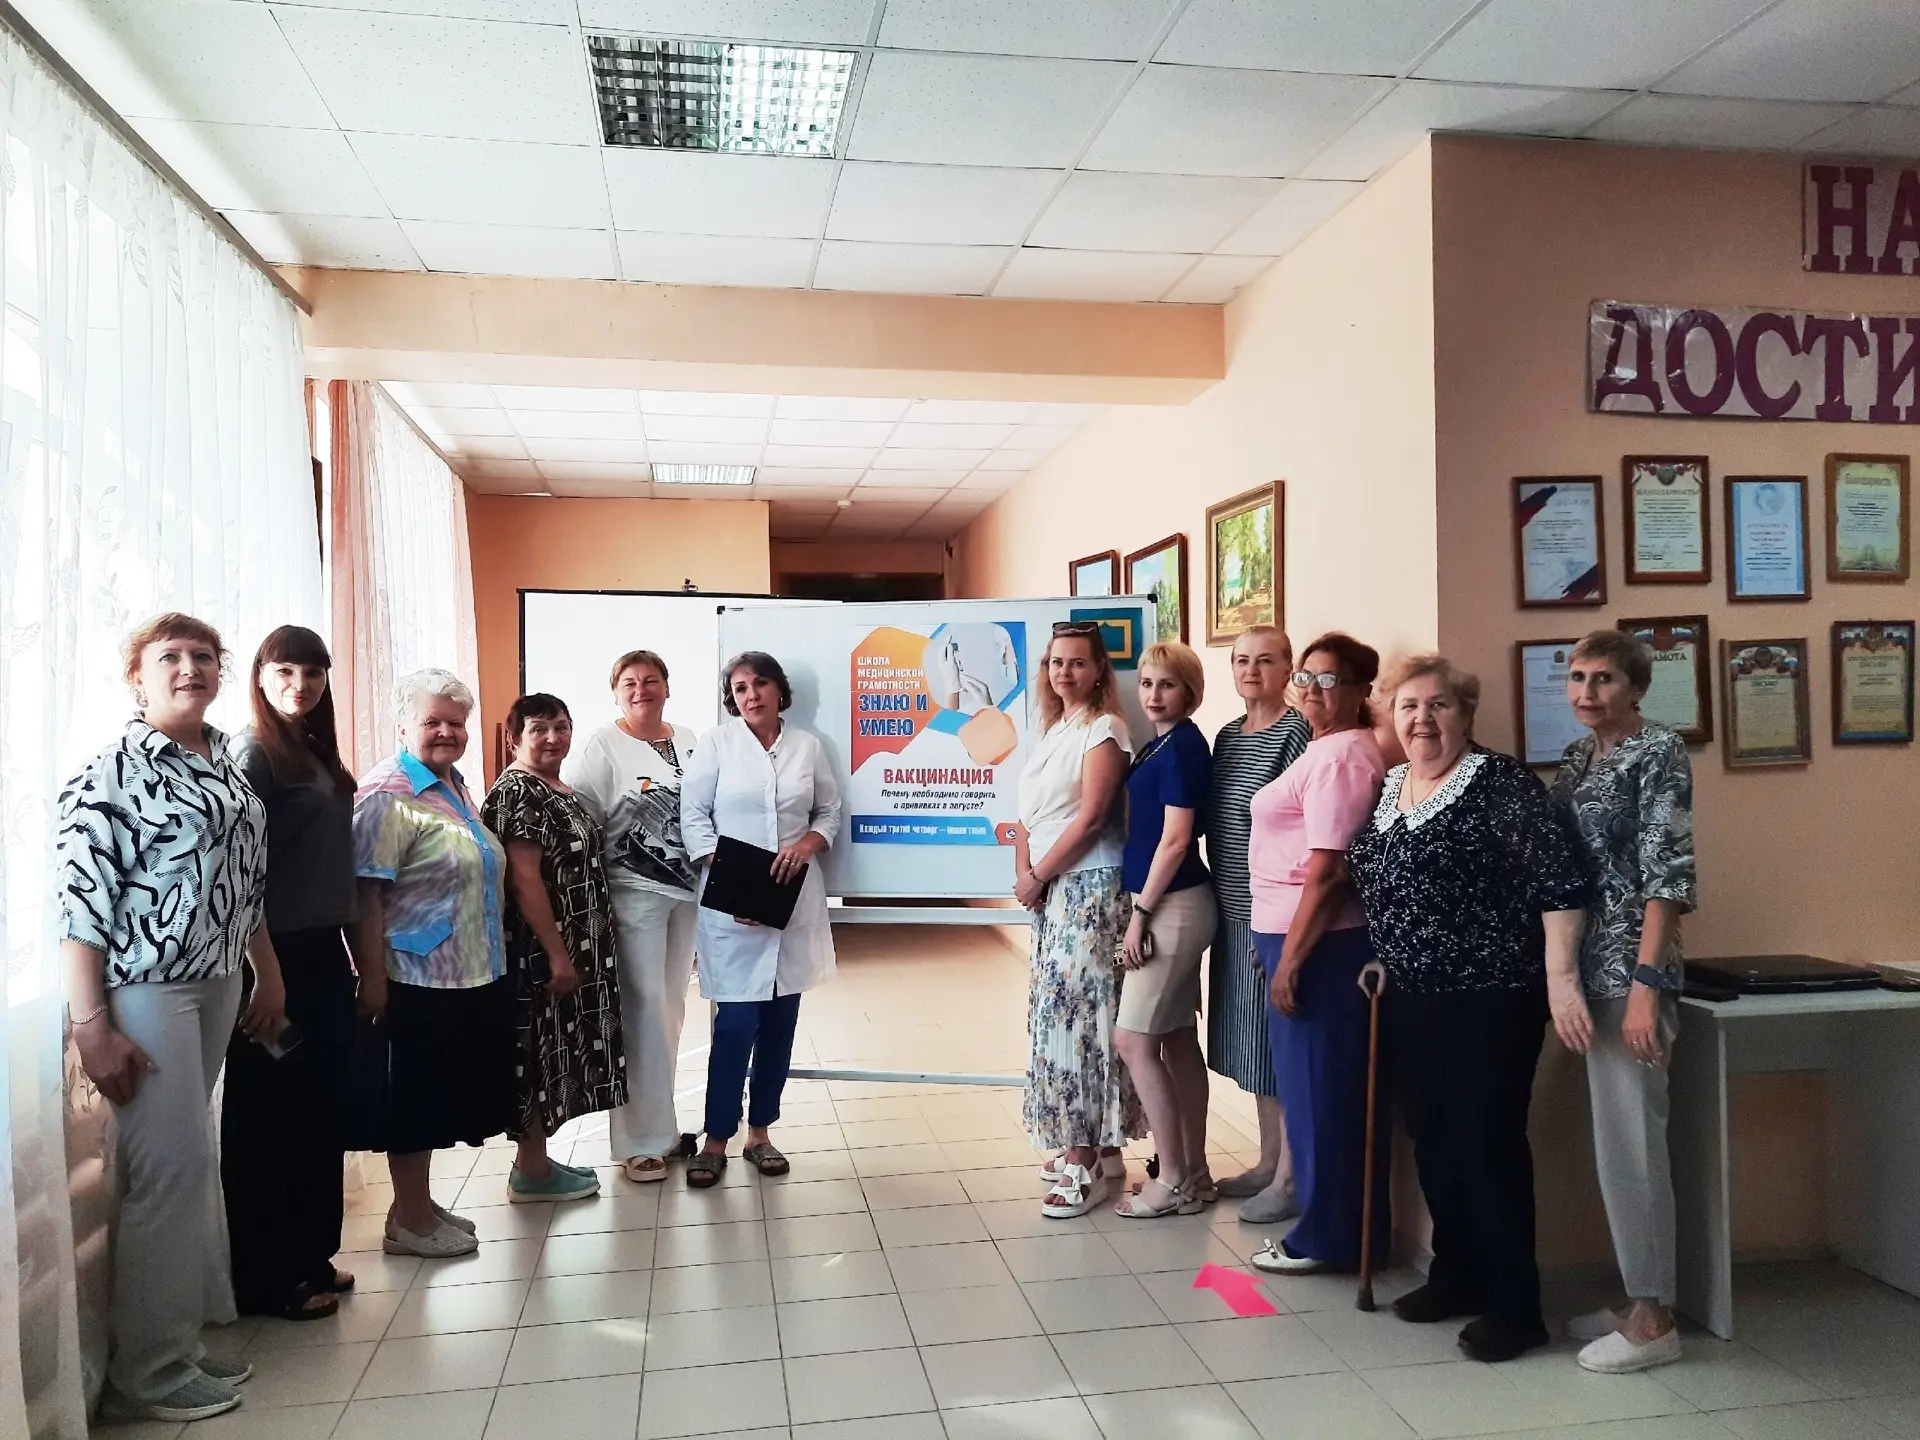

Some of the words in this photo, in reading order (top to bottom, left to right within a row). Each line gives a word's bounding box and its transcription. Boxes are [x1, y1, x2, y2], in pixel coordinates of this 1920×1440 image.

[1594, 308, 1920, 422] ДОСТИ
[857, 656, 891, 666] ШКОЛА
[857, 680, 921, 690] ГРАМОТНОСТИ
[858, 692, 911, 712] ЗНАЮ
[915, 693, 928, 712] И
[858, 718, 914, 736] УМЕЮ
[883, 768, 994, 787] ВАКЦИНАЦИЯ
[881, 789, 910, 799] Почему
[912, 789, 959, 799] необходимо
[961, 790, 996, 800] говорить
[900, 802, 940, 811] прививках
[949, 801, 984, 812] августе?
